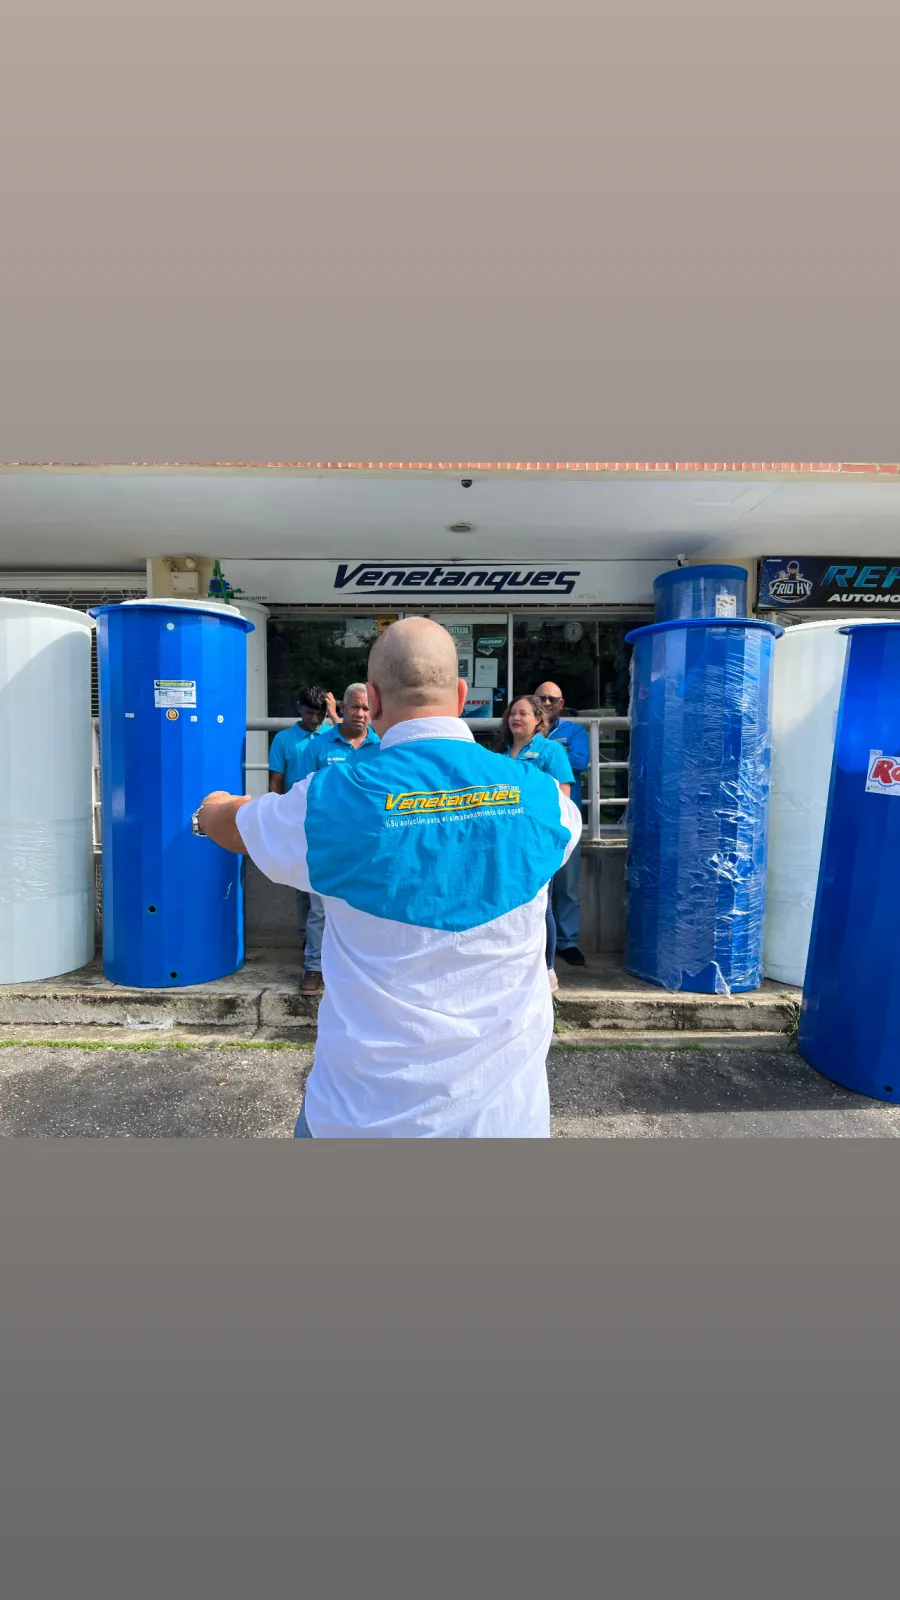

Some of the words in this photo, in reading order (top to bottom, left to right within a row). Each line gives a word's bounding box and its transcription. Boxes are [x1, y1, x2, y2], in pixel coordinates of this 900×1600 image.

[333, 563, 581, 595] Venetanques
[771, 582, 794, 595] FRIO
[385, 787, 521, 812] Venetanques
[427, 817, 441, 826] para
